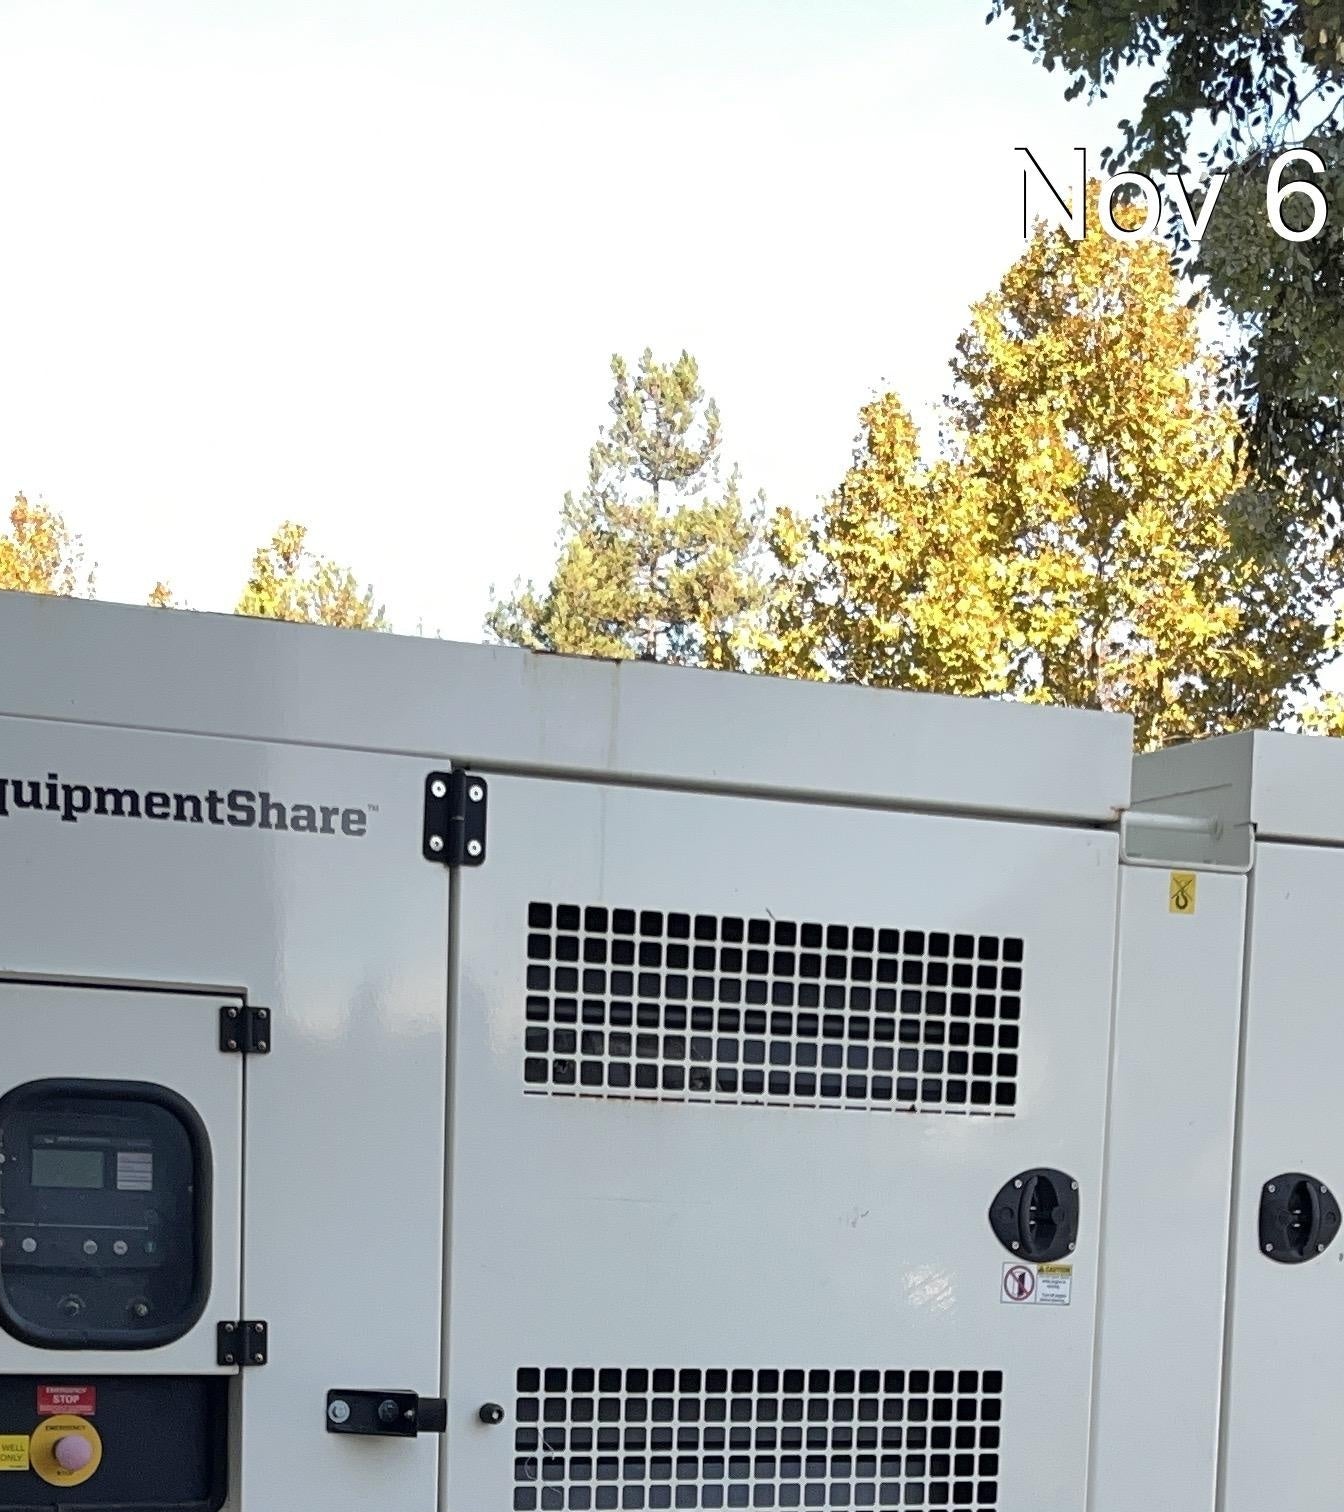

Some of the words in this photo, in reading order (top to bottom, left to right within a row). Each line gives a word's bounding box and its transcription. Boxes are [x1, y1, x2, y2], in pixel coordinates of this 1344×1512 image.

[52, 1394, 80, 1404] STOP
[1, 1443, 25, 1452] WELL
[0, 1453, 23, 1462] ONLY
